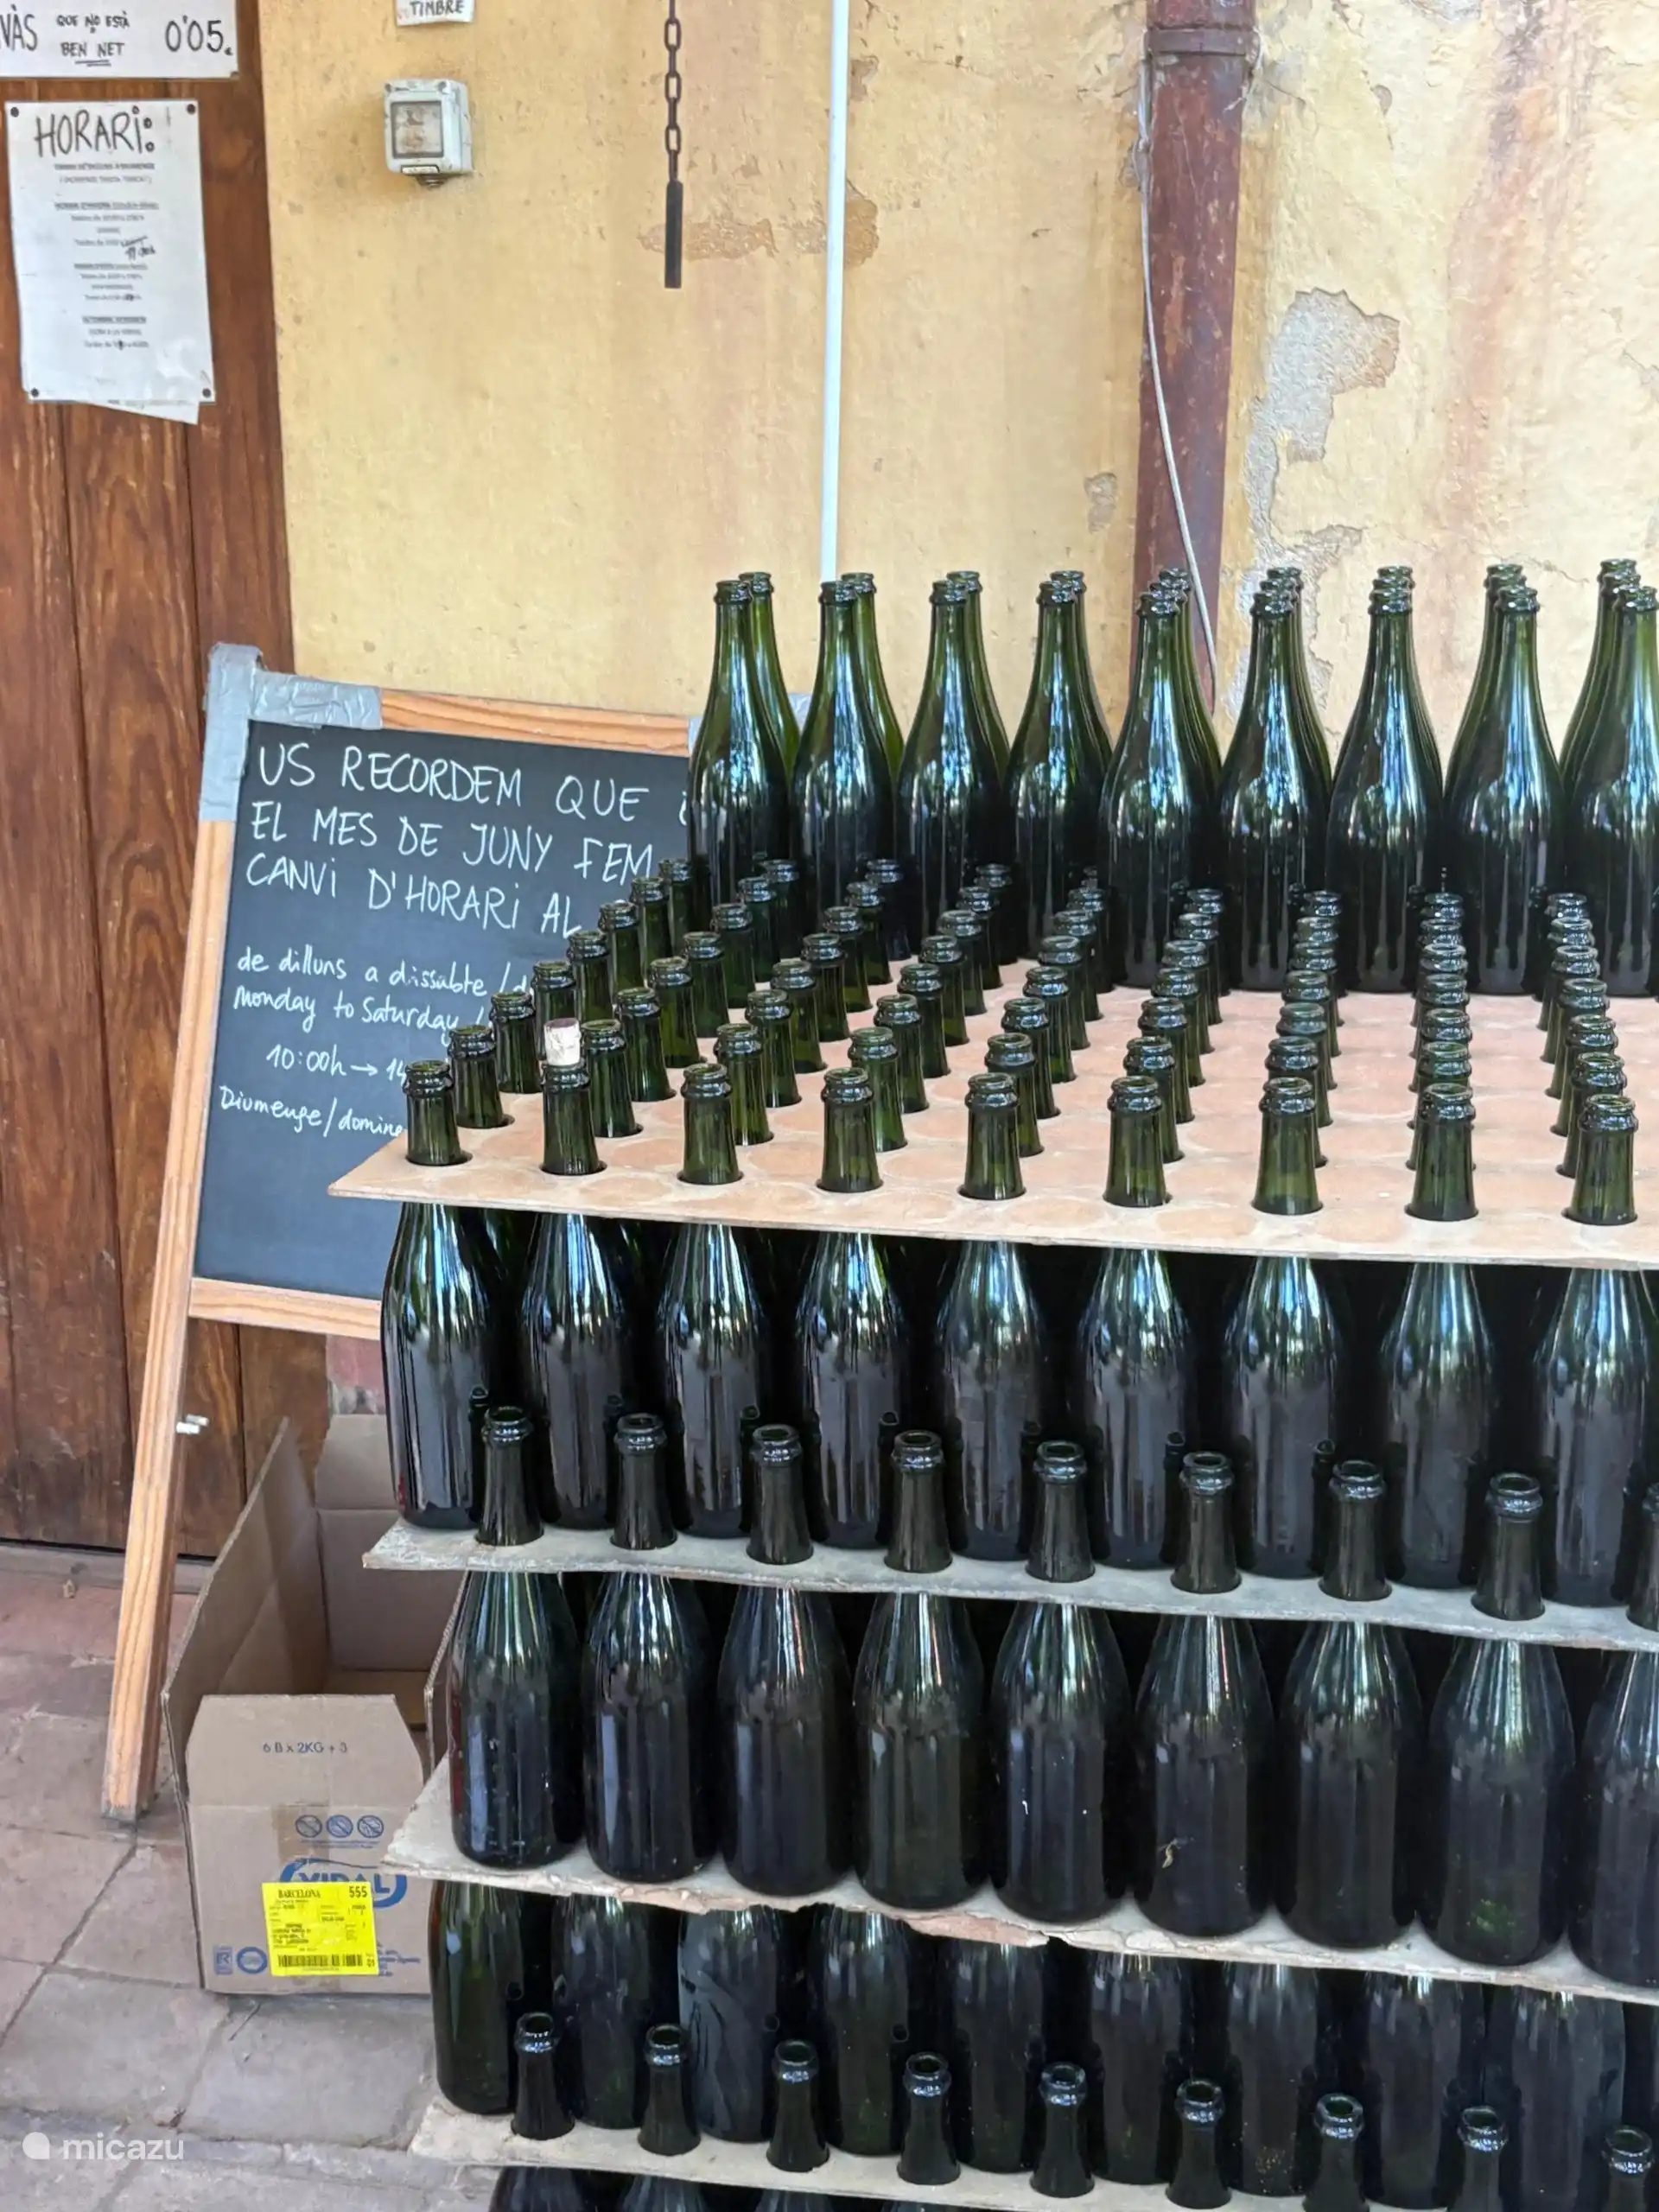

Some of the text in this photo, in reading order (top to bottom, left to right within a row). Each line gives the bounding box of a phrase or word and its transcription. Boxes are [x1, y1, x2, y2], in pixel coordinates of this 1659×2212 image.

[56, 16, 79, 27] QUE
[410, 0, 465, 17] TIMBRE
[60, 42, 124, 57] BEN NET
[259, 742, 315, 787] US
[341, 746, 522, 807] RECORDEM
[556, 775, 650, 822] QUE
[251, 801, 653, 886] EL MES DE JUNY FEM
[541, 892, 582, 939] AL
[237, 945, 270, 972] de
[278, 944, 347, 980] dilluns
[365, 965, 378, 983] a
[233, 984, 316, 1033] Monday
[334, 989, 354, 1019] to
[361, 994, 460, 1047] Saturday
[297, 1742, 325, 1753] 2KG
[349, 1885, 368, 1898] 555
